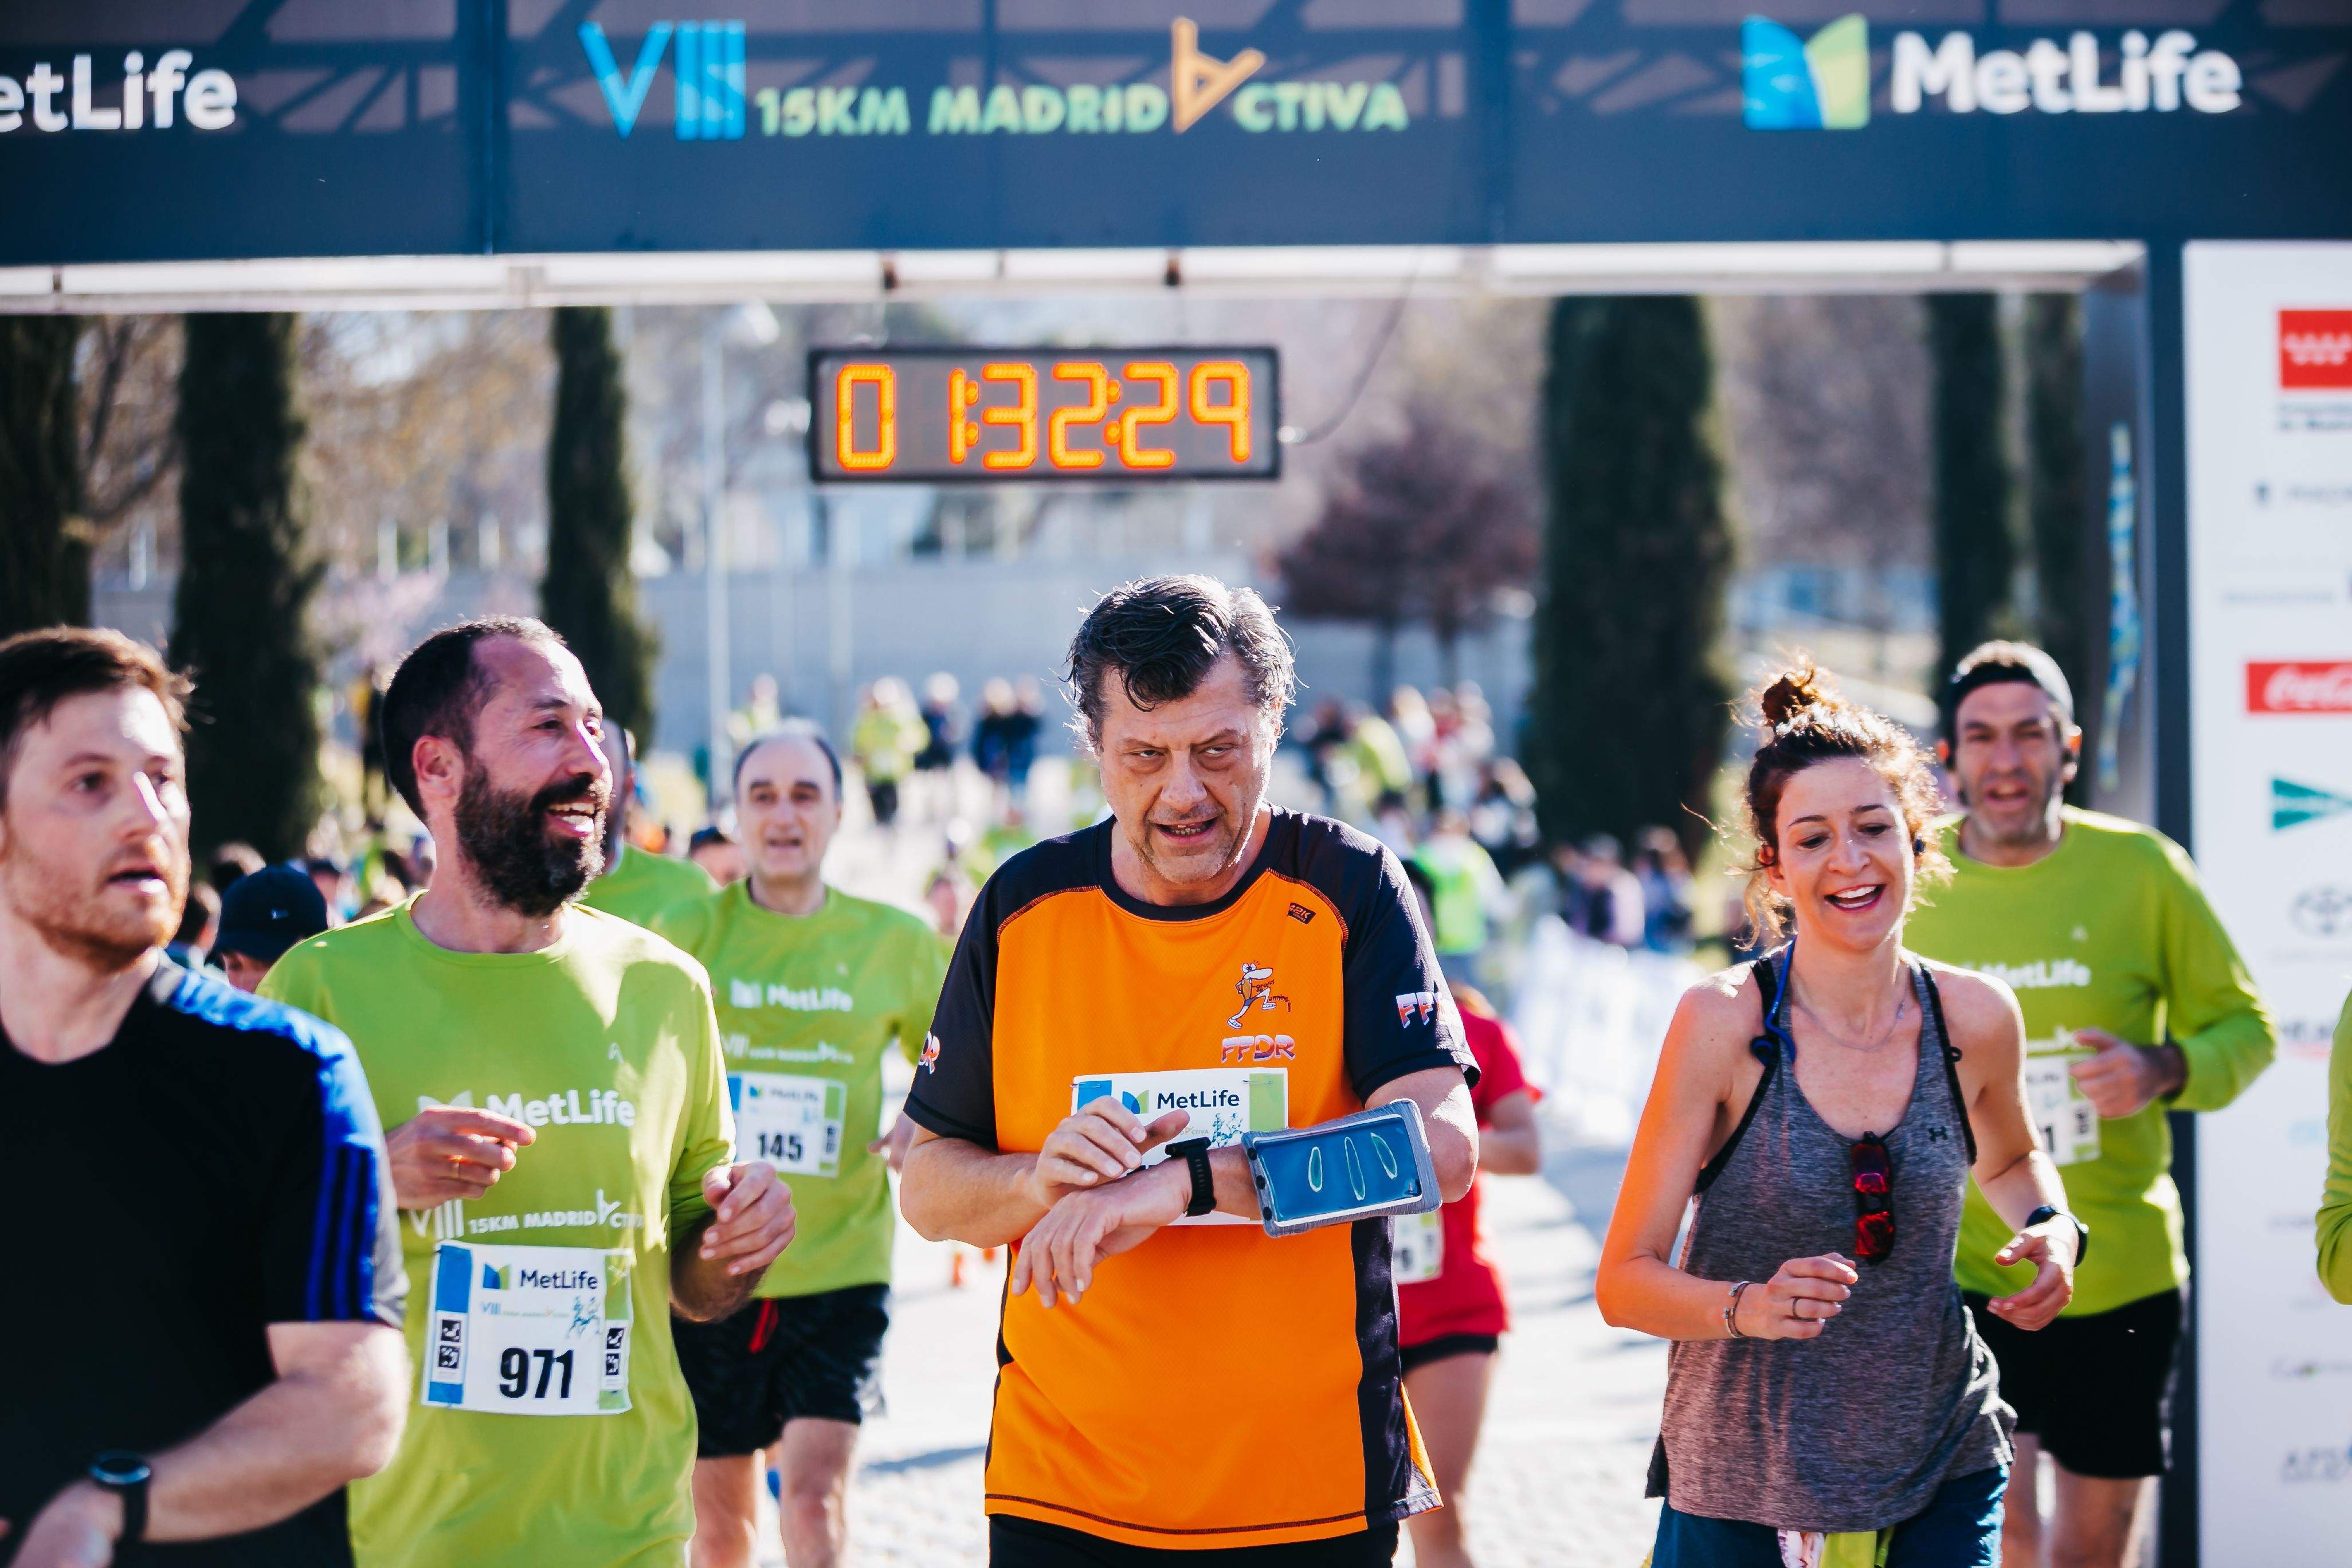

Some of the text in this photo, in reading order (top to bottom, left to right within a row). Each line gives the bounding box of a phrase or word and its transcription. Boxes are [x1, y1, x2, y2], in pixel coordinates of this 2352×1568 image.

[578, 19, 746, 139] VIII
[756, 85, 911, 136] 15KM
[927, 84, 1169, 134] MADRID
[1891, 30, 2242, 114] MetLife
[1221, 1034, 1296, 1064] FFDR
[486, 1088, 636, 1127] MetLife
[1157, 1089, 1240, 1110] MetLife
[758, 1132, 803, 1162] 145
[469, 1214, 519, 1234] 15KM
[523, 1210, 597, 1229] MADRID
[520, 1269, 598, 1289] MetLife
[499, 1347, 575, 1399] 971
